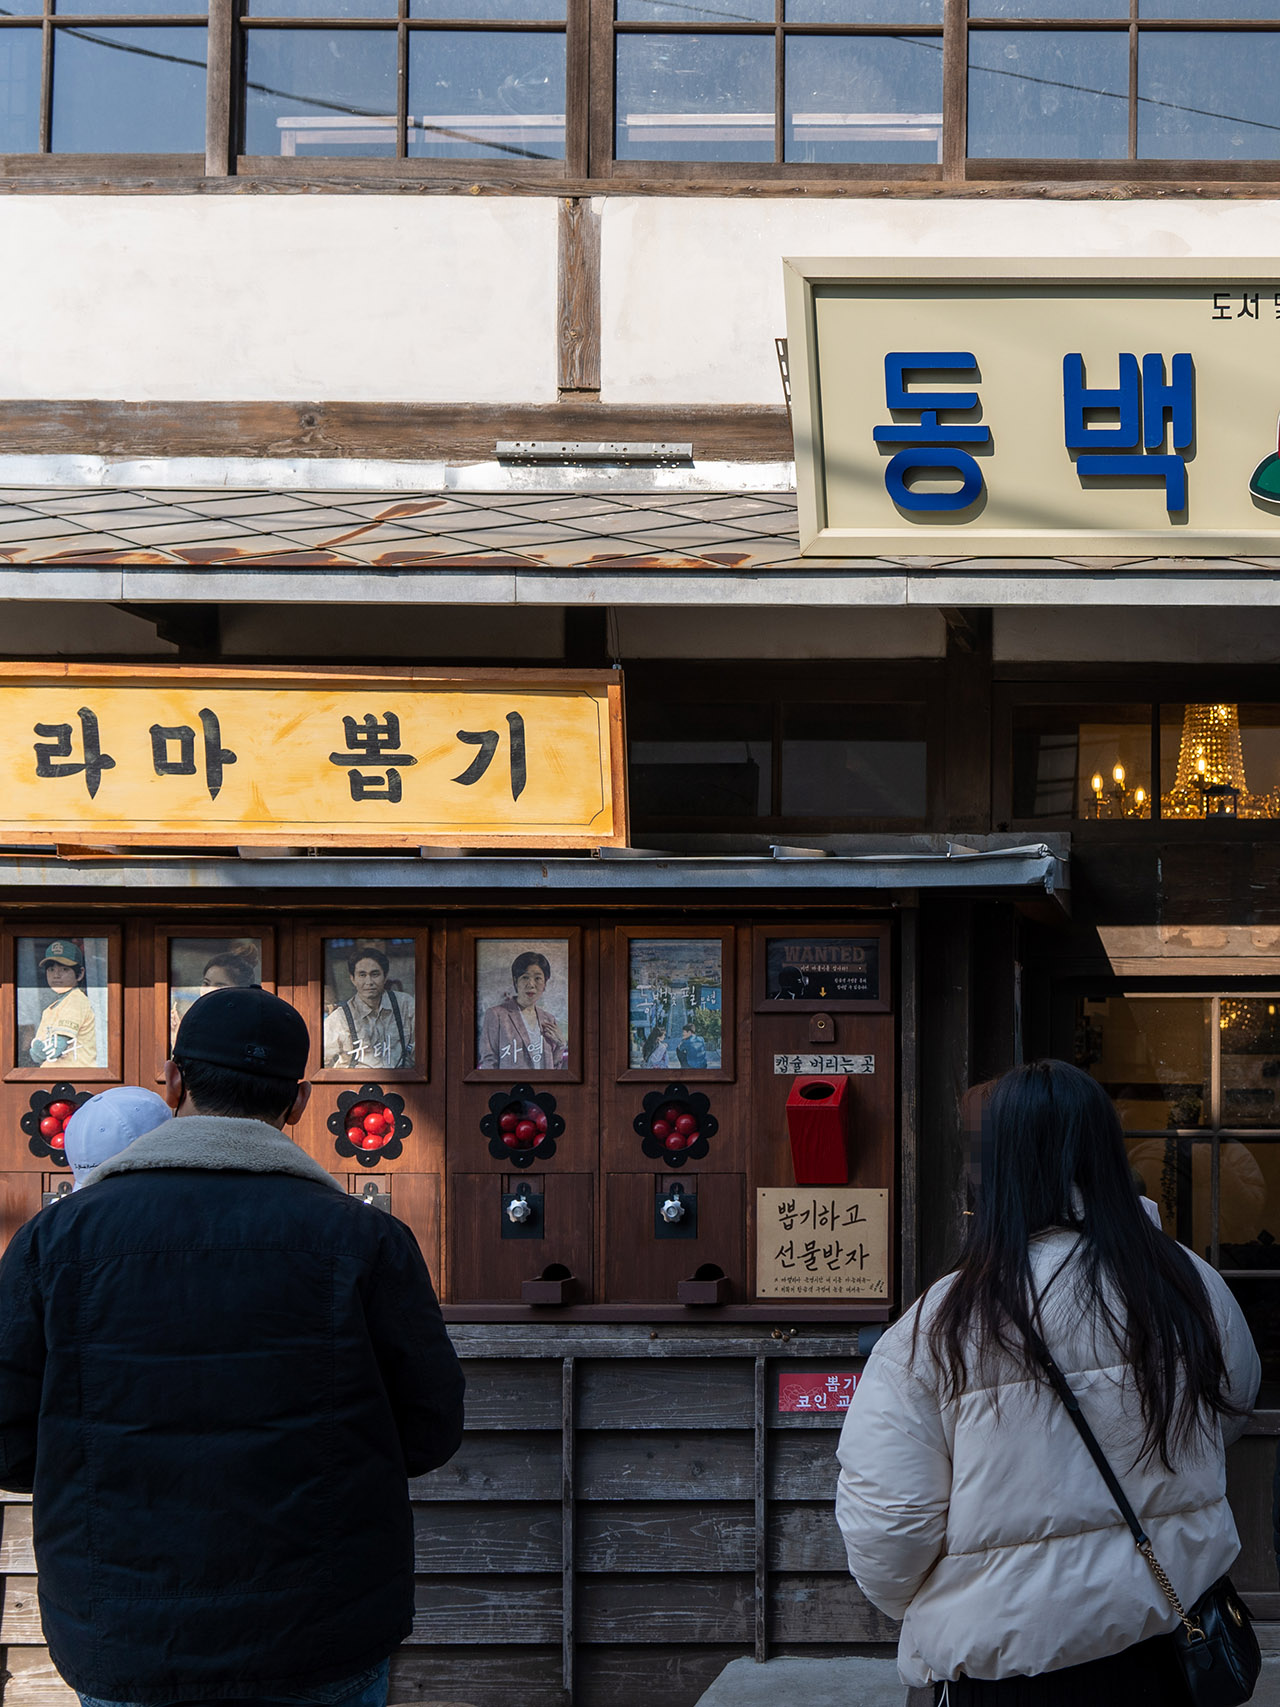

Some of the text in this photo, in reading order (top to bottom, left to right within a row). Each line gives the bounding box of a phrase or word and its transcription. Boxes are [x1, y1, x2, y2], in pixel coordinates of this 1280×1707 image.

[1212, 293, 1259, 319] 도서
[872, 351, 1194, 512] 동백
[328, 710, 527, 804] 뽑기
[784, 946, 865, 962] WANTED
[347, 1034, 391, 1065] 규태
[500, 1035, 543, 1064] 자영
[776, 1056, 874, 1073] 캡슐 버리는 곳
[778, 1199, 867, 1231] 뽑기하고
[775, 1240, 870, 1271] 선물받자
[825, 1376, 857, 1392] 뽑기
[796, 1393, 827, 1409] 코인
